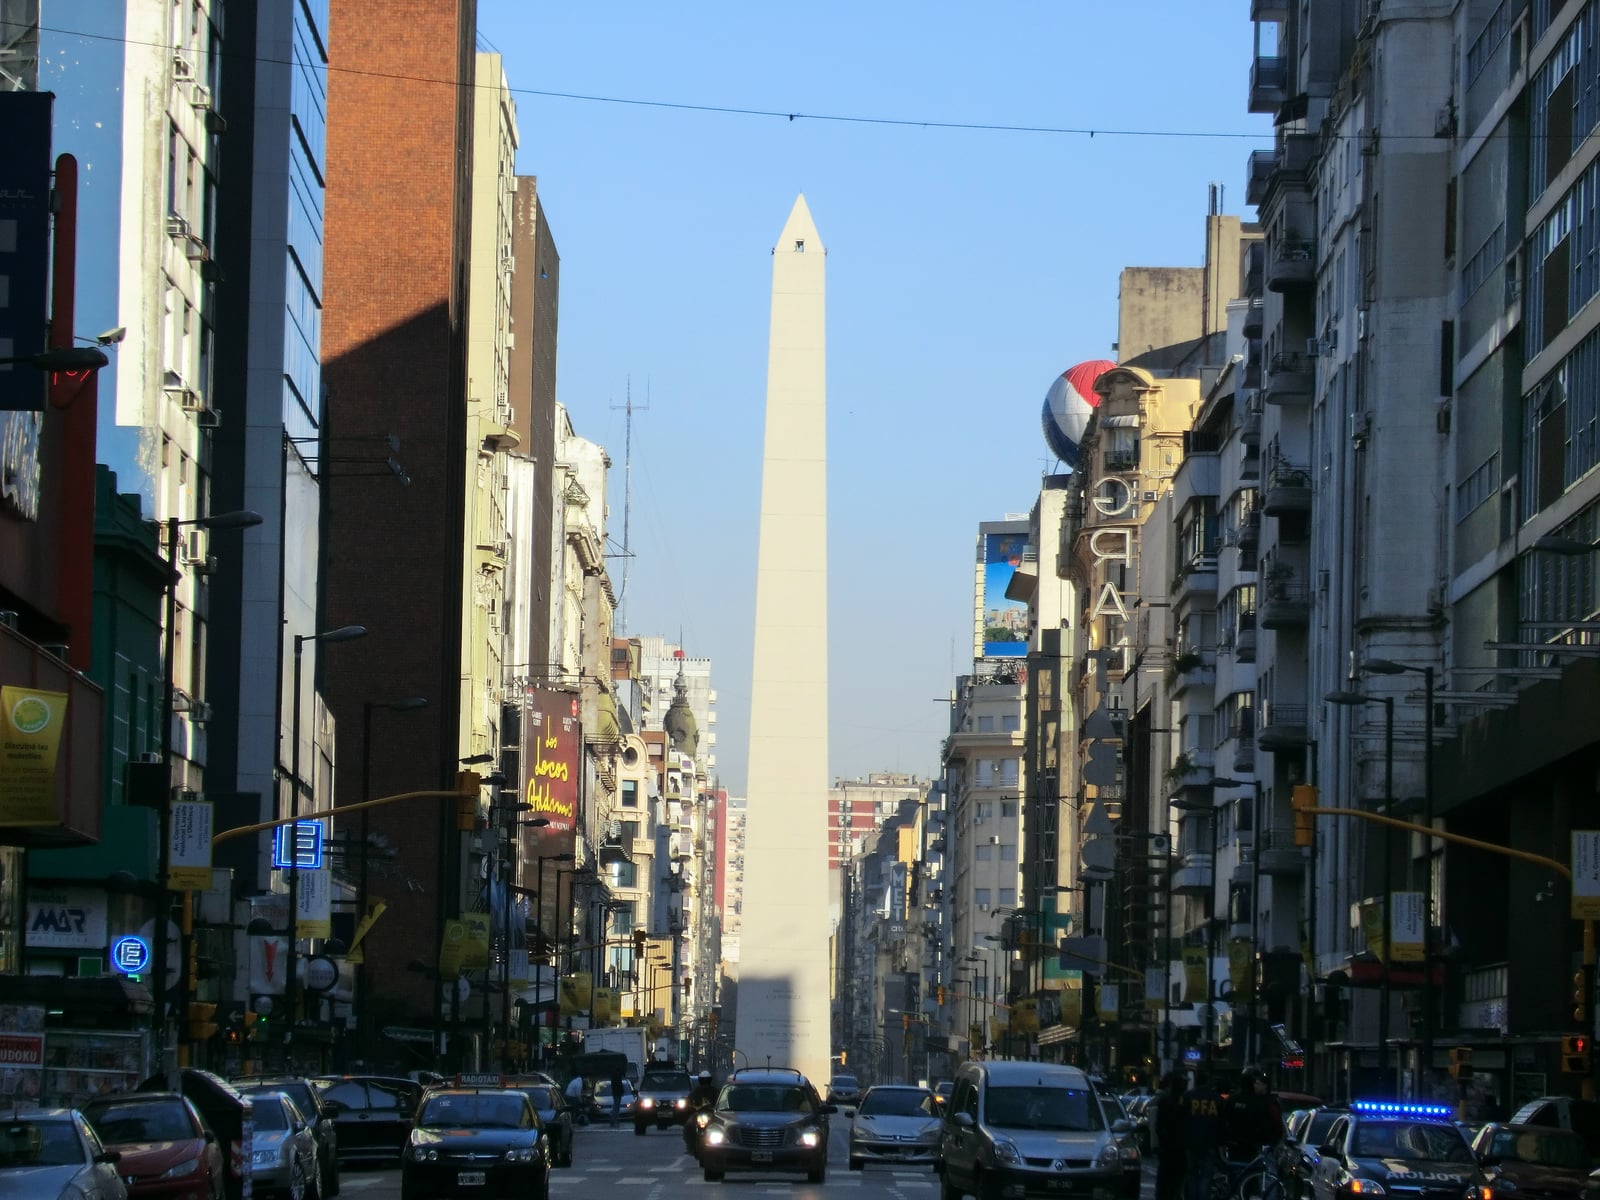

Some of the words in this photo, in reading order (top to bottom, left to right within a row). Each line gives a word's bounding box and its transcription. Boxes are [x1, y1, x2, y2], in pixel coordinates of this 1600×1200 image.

[534, 735, 568, 782] Locos
[281, 824, 316, 865] E
[31, 908, 86, 933] MAR
[120, 942, 141, 966] E
[0, 1048, 37, 1062] UDOKU
[461, 1074, 499, 1084] RADIOTAXI
[1191, 1099, 1218, 1117] PFA
